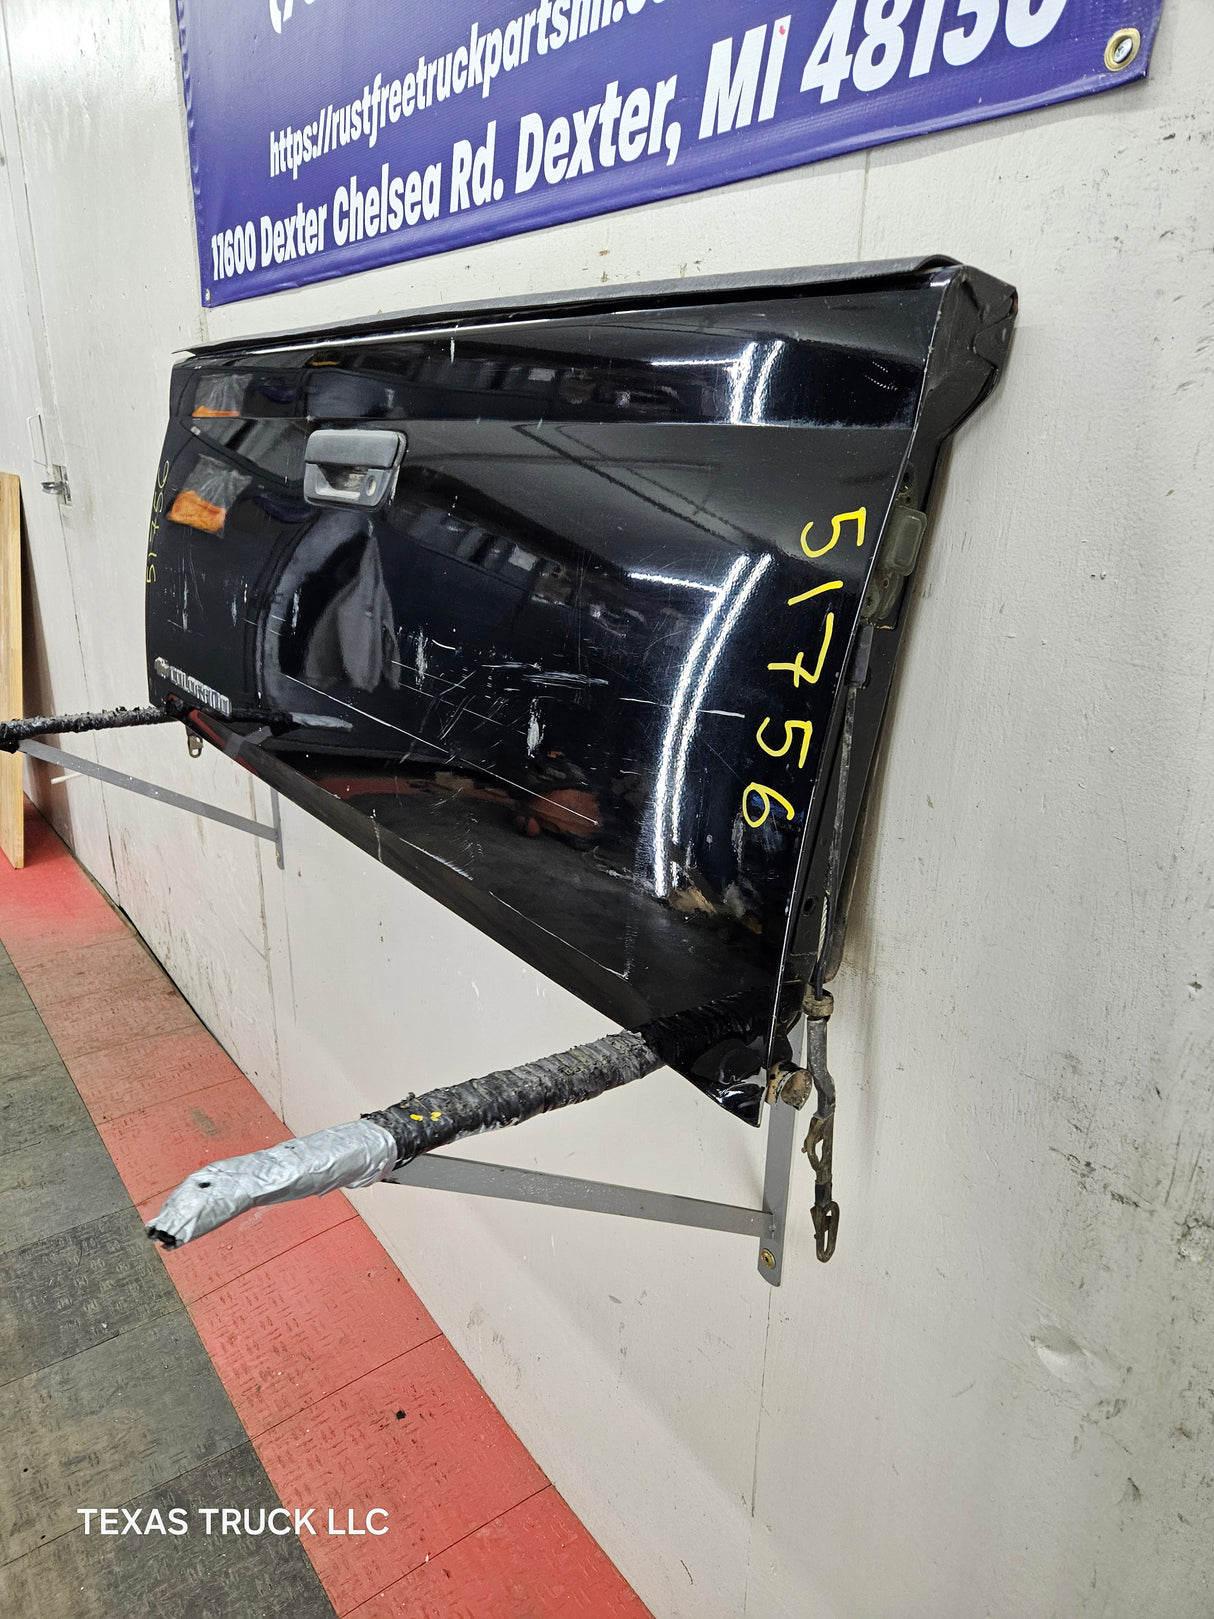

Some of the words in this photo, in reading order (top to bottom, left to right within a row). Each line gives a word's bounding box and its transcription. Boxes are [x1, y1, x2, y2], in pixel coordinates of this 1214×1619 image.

[211, 220, 257, 281] 11600
[261, 202, 328, 268] Dexter
[333, 162, 442, 246] Chelsea
[450, 120, 504, 214] Rd.
[514, 74, 682, 194] Dexter,
[698, 15, 792, 140] MI
[269, 0, 665, 181] https://rustfreetruckpartsm.
[742, 506, 867, 829] 51756
